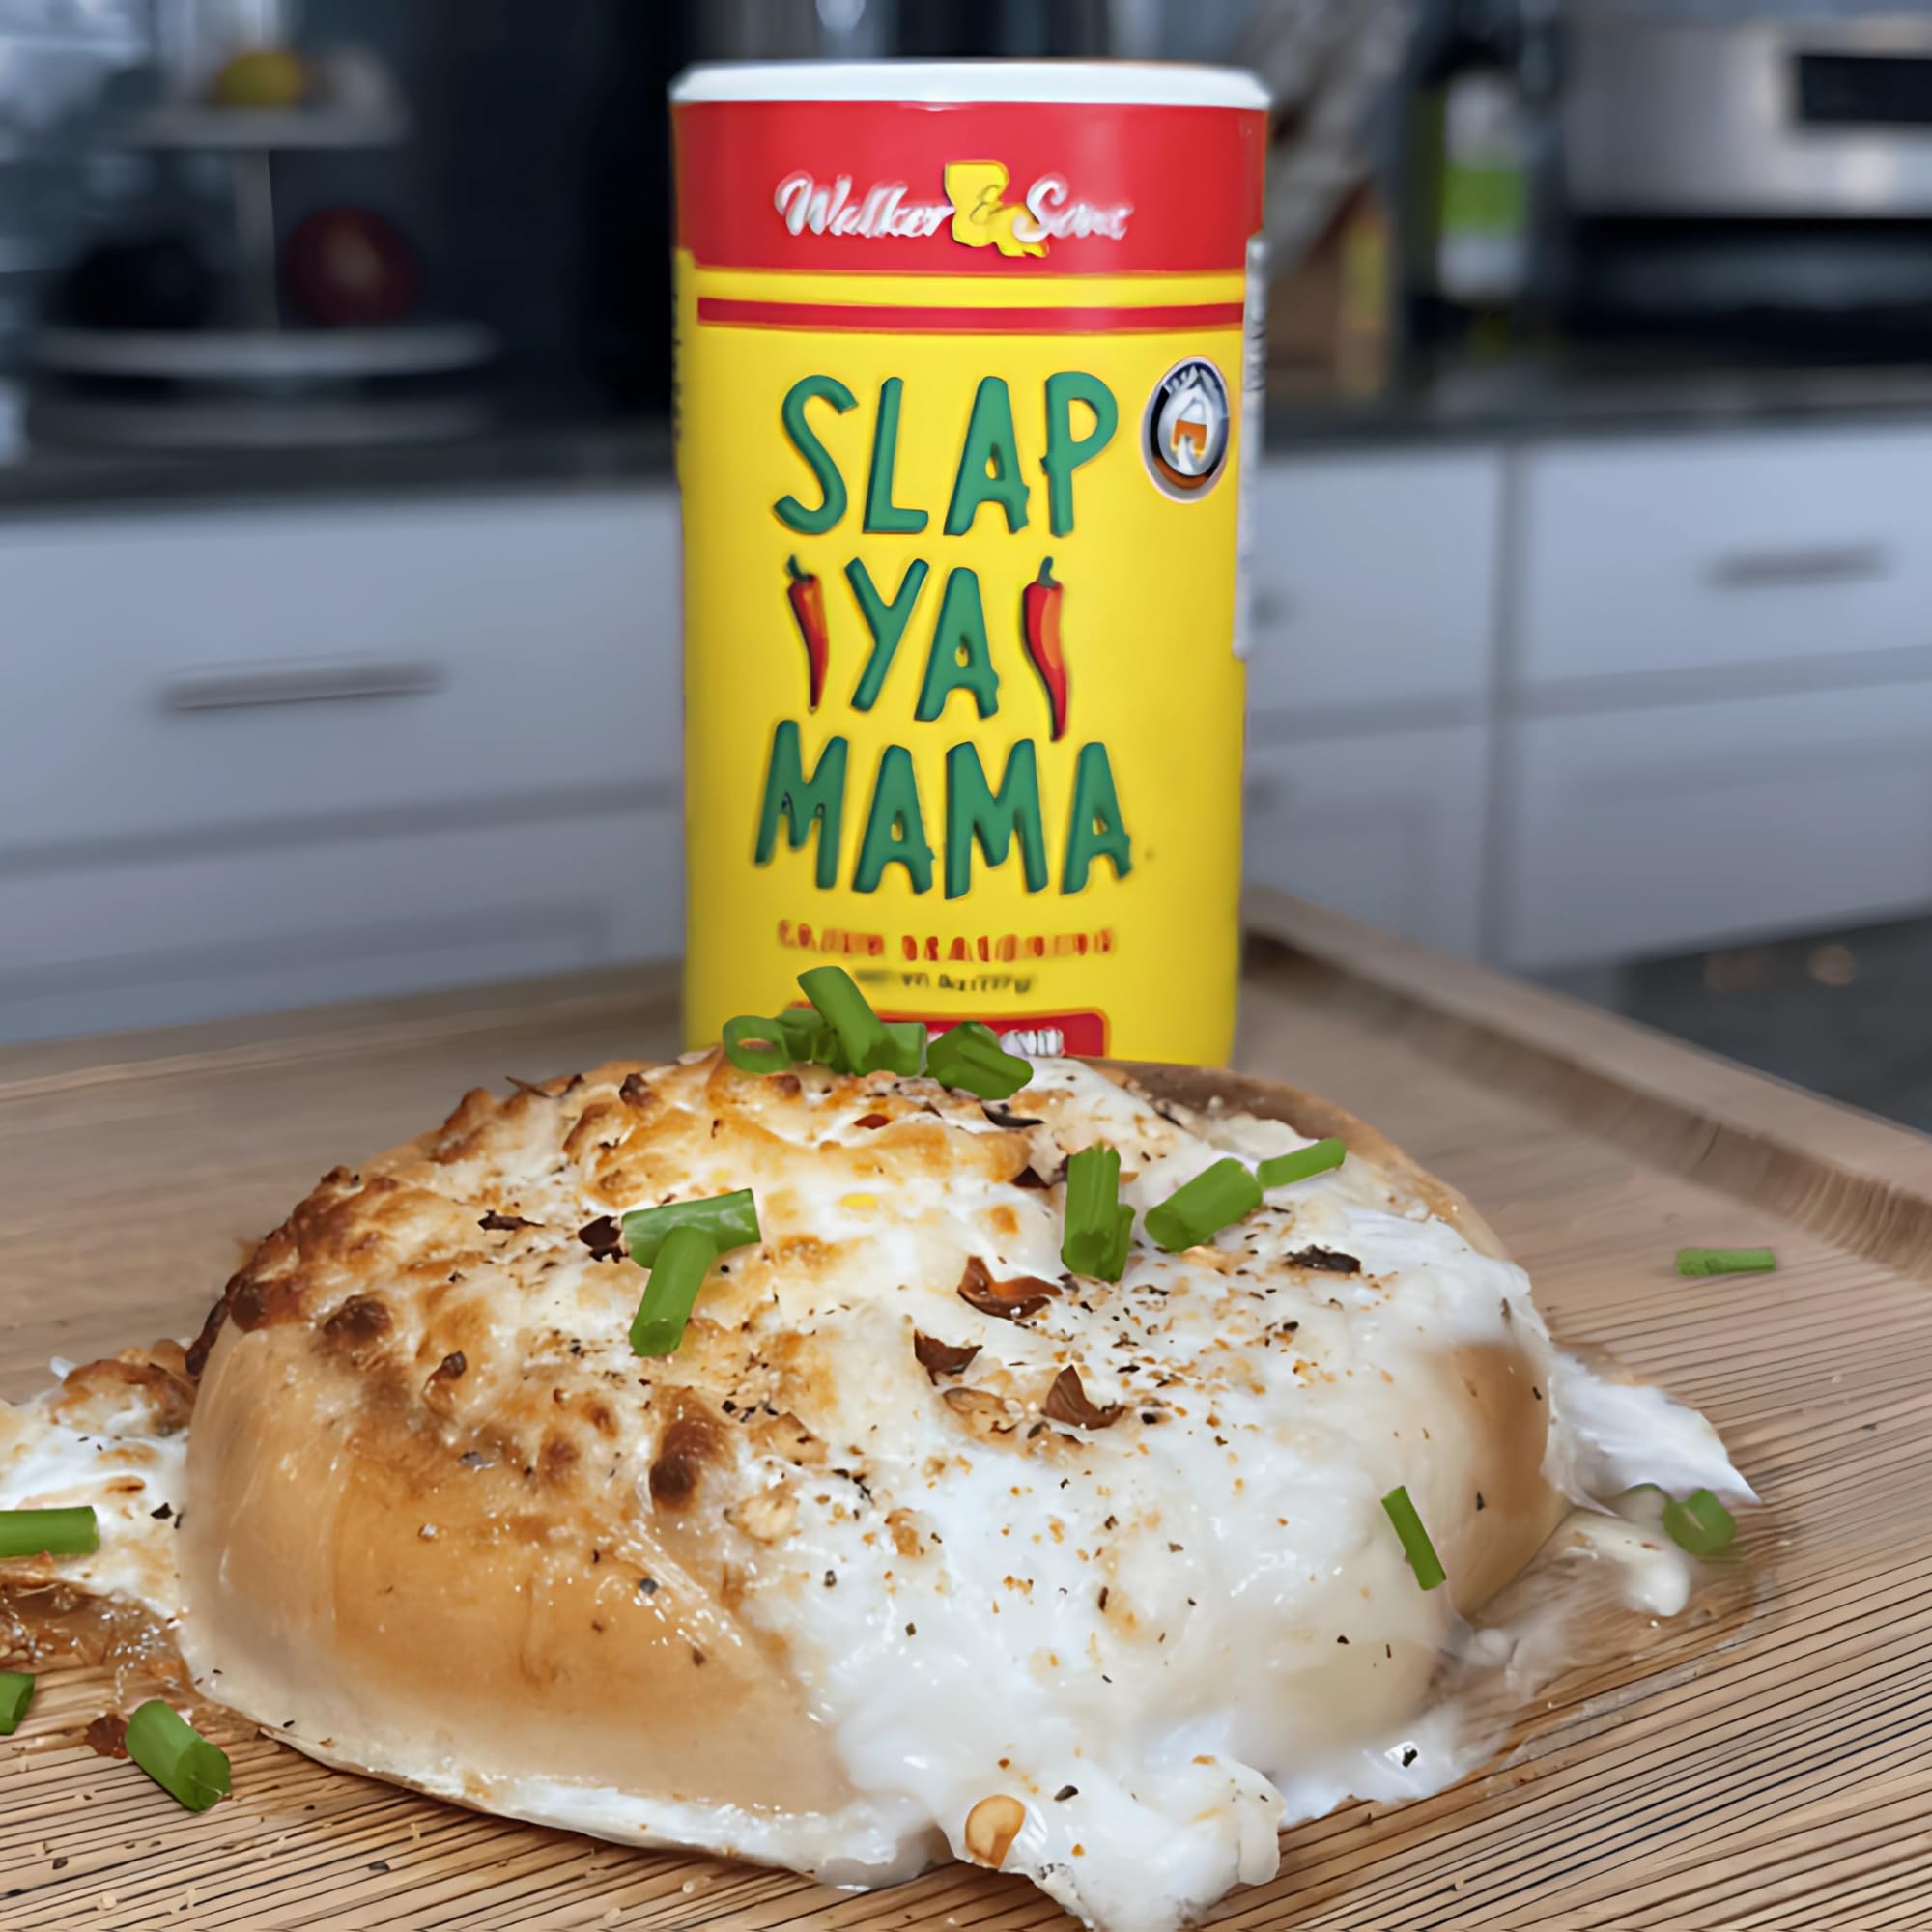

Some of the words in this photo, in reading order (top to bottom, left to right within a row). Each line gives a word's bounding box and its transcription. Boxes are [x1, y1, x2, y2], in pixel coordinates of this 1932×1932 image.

[774, 371, 1119, 538] SLAP
[844, 557, 1000, 722] YA
[754, 719, 1133, 900] MAMA
